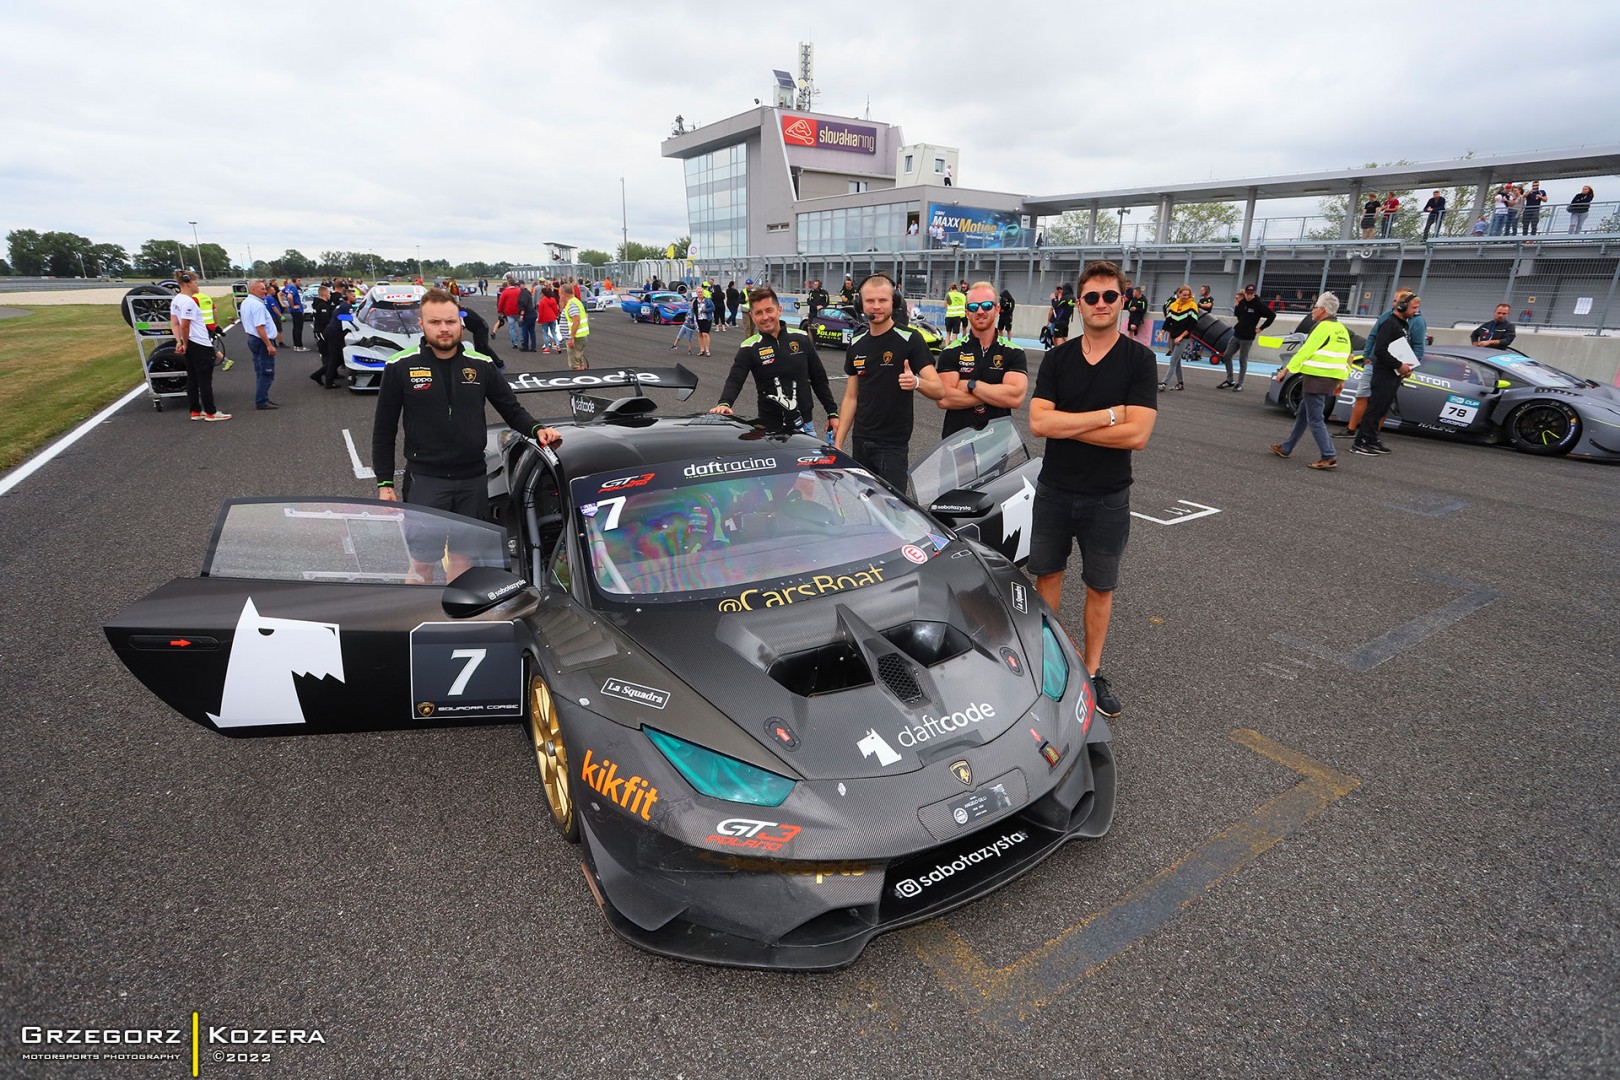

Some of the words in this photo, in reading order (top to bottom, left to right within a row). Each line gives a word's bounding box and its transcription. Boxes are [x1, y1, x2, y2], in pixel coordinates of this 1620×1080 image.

[1448, 406, 1467, 418] 78
[683, 457, 777, 477] daftracing
[601, 472, 656, 488] GT3
[597, 496, 626, 531] 7
[447, 648, 487, 696] 7
[607, 682, 620, 692] La
[622, 685, 663, 704] Squadra
[898, 701, 996, 748] daftcode
[581, 749, 658, 821] kikfit
[704, 834, 783, 851] POLAND
[716, 818, 802, 843] GT3
[919, 831, 1026, 888] sabotazysta
